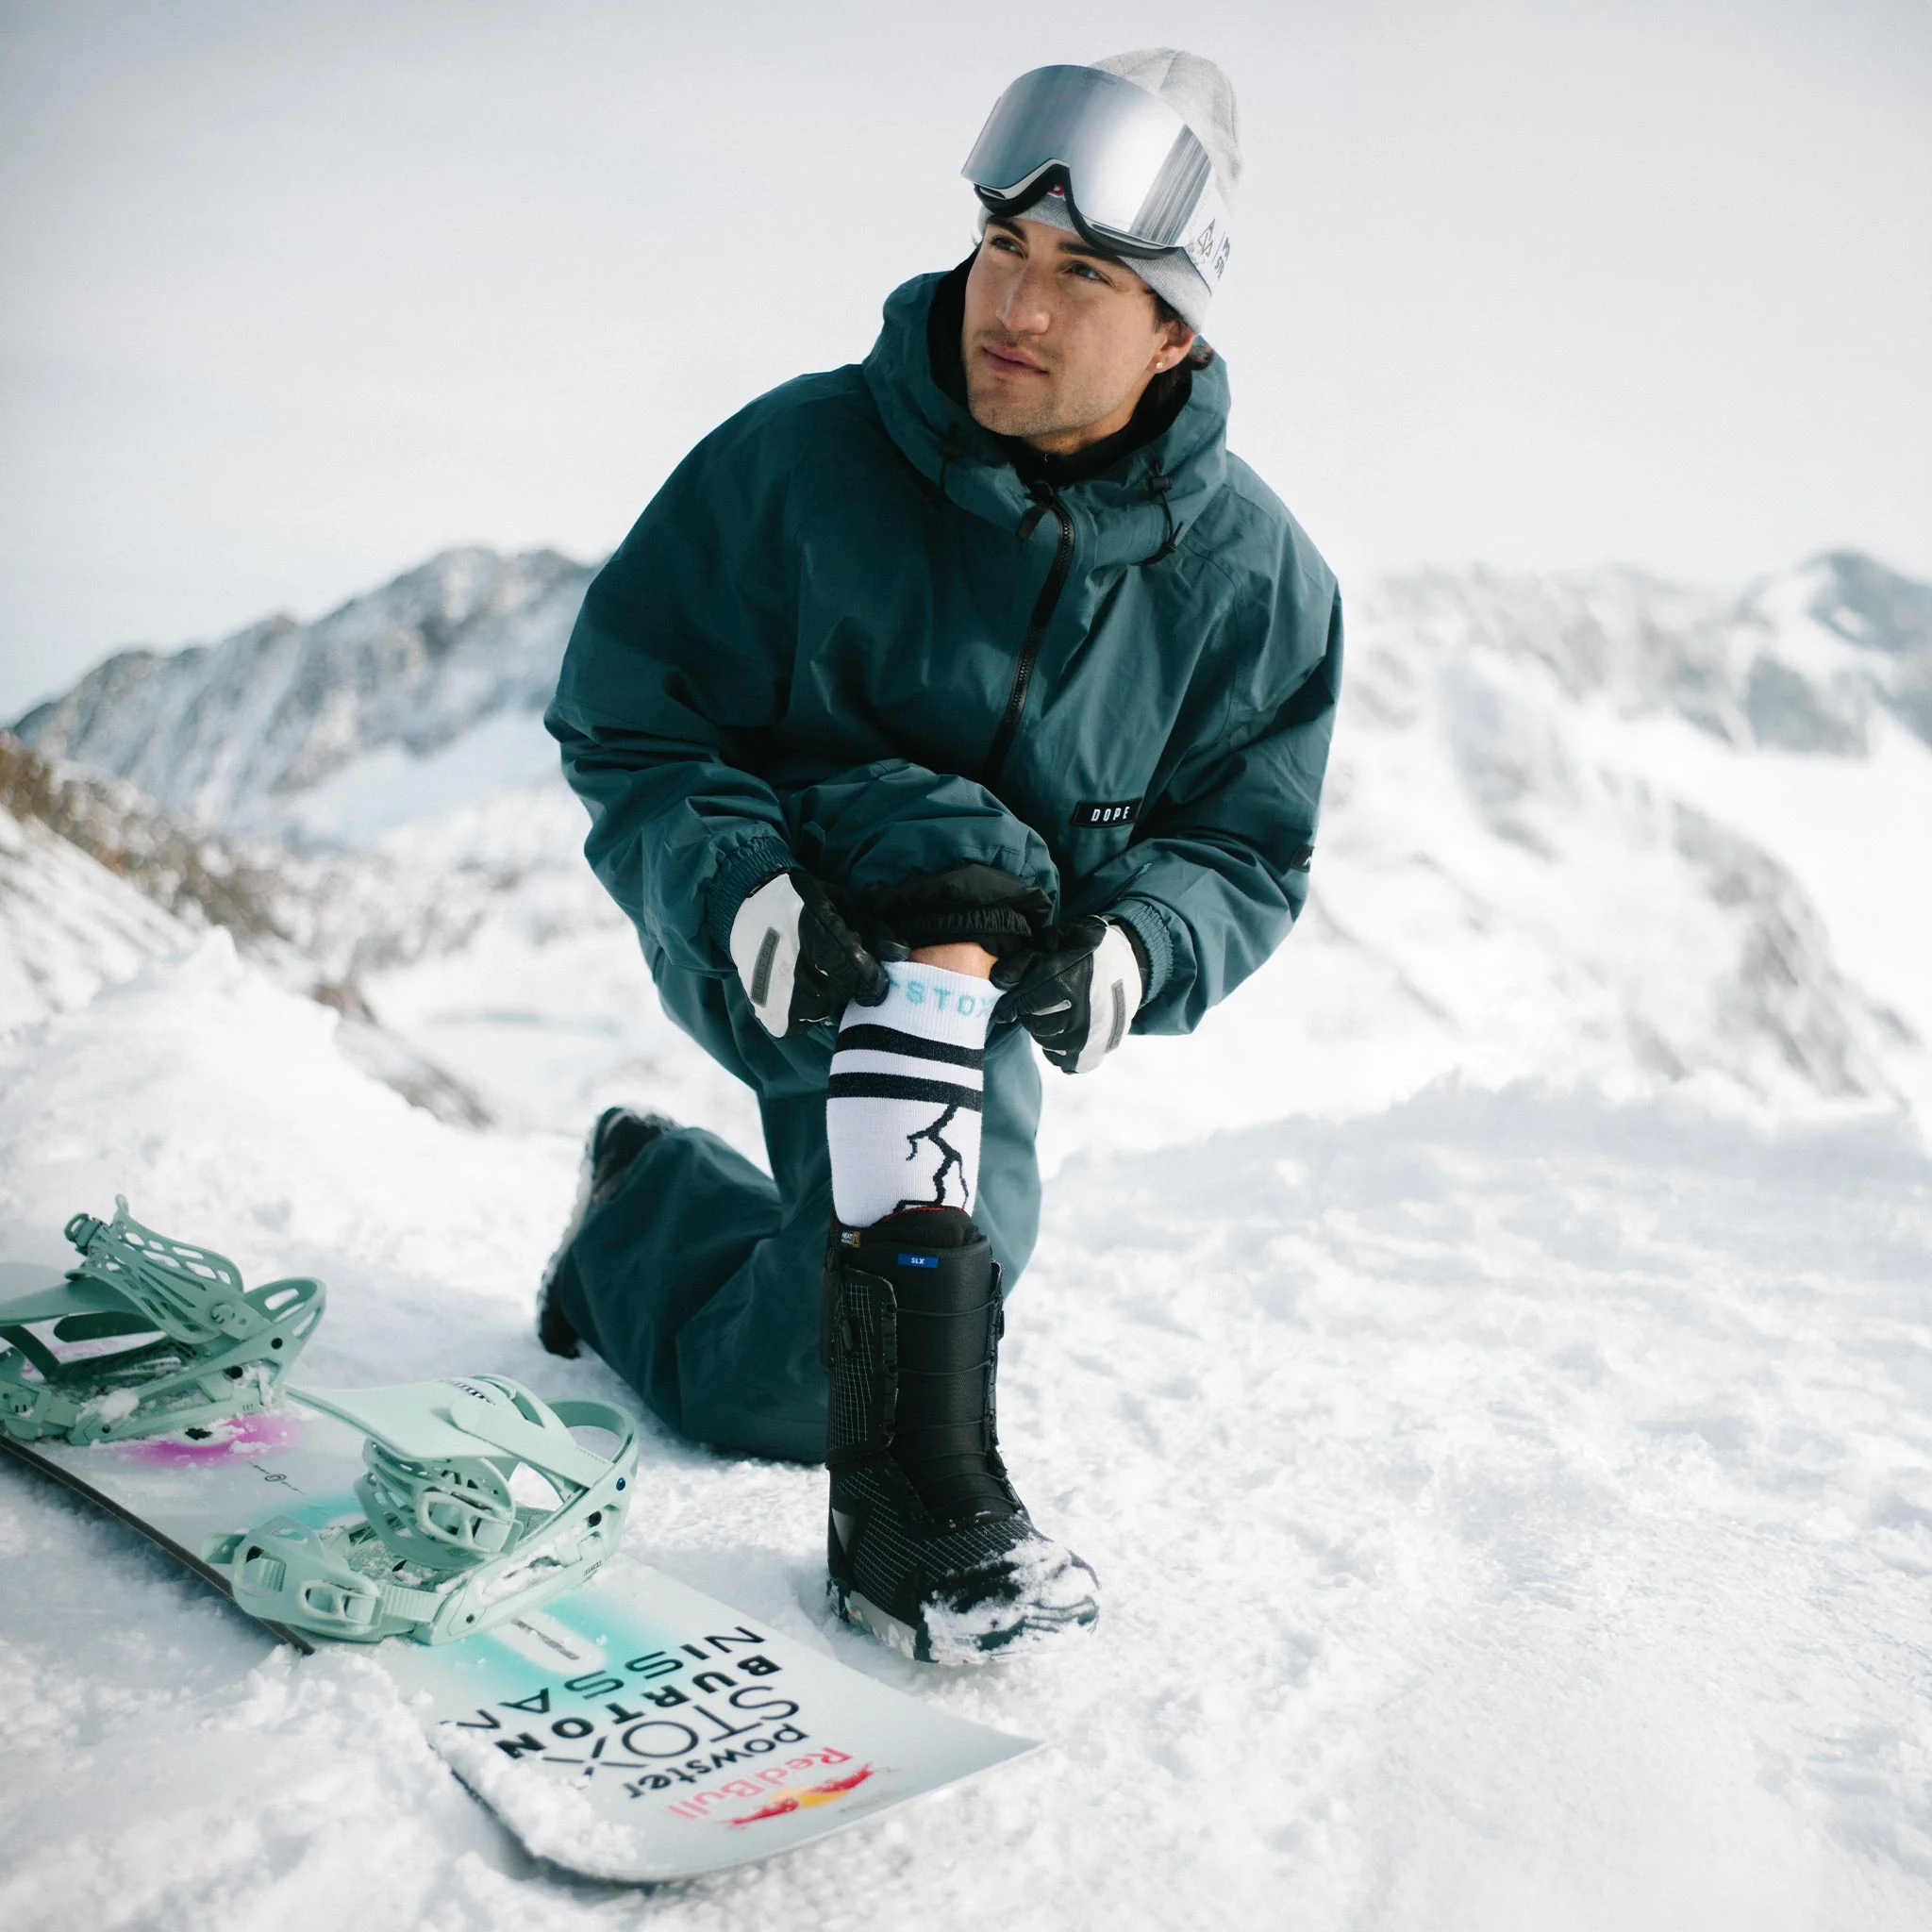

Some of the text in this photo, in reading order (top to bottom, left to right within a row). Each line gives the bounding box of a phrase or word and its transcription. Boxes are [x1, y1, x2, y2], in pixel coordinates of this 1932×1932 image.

[1091, 806, 1130, 822] DOPE
[910, 1257, 925, 1265] SLX
[493, 1655, 783, 1759] BURTON
[541, 1686, 800, 1778] STOX
[623, 1723, 810, 1799] powster
